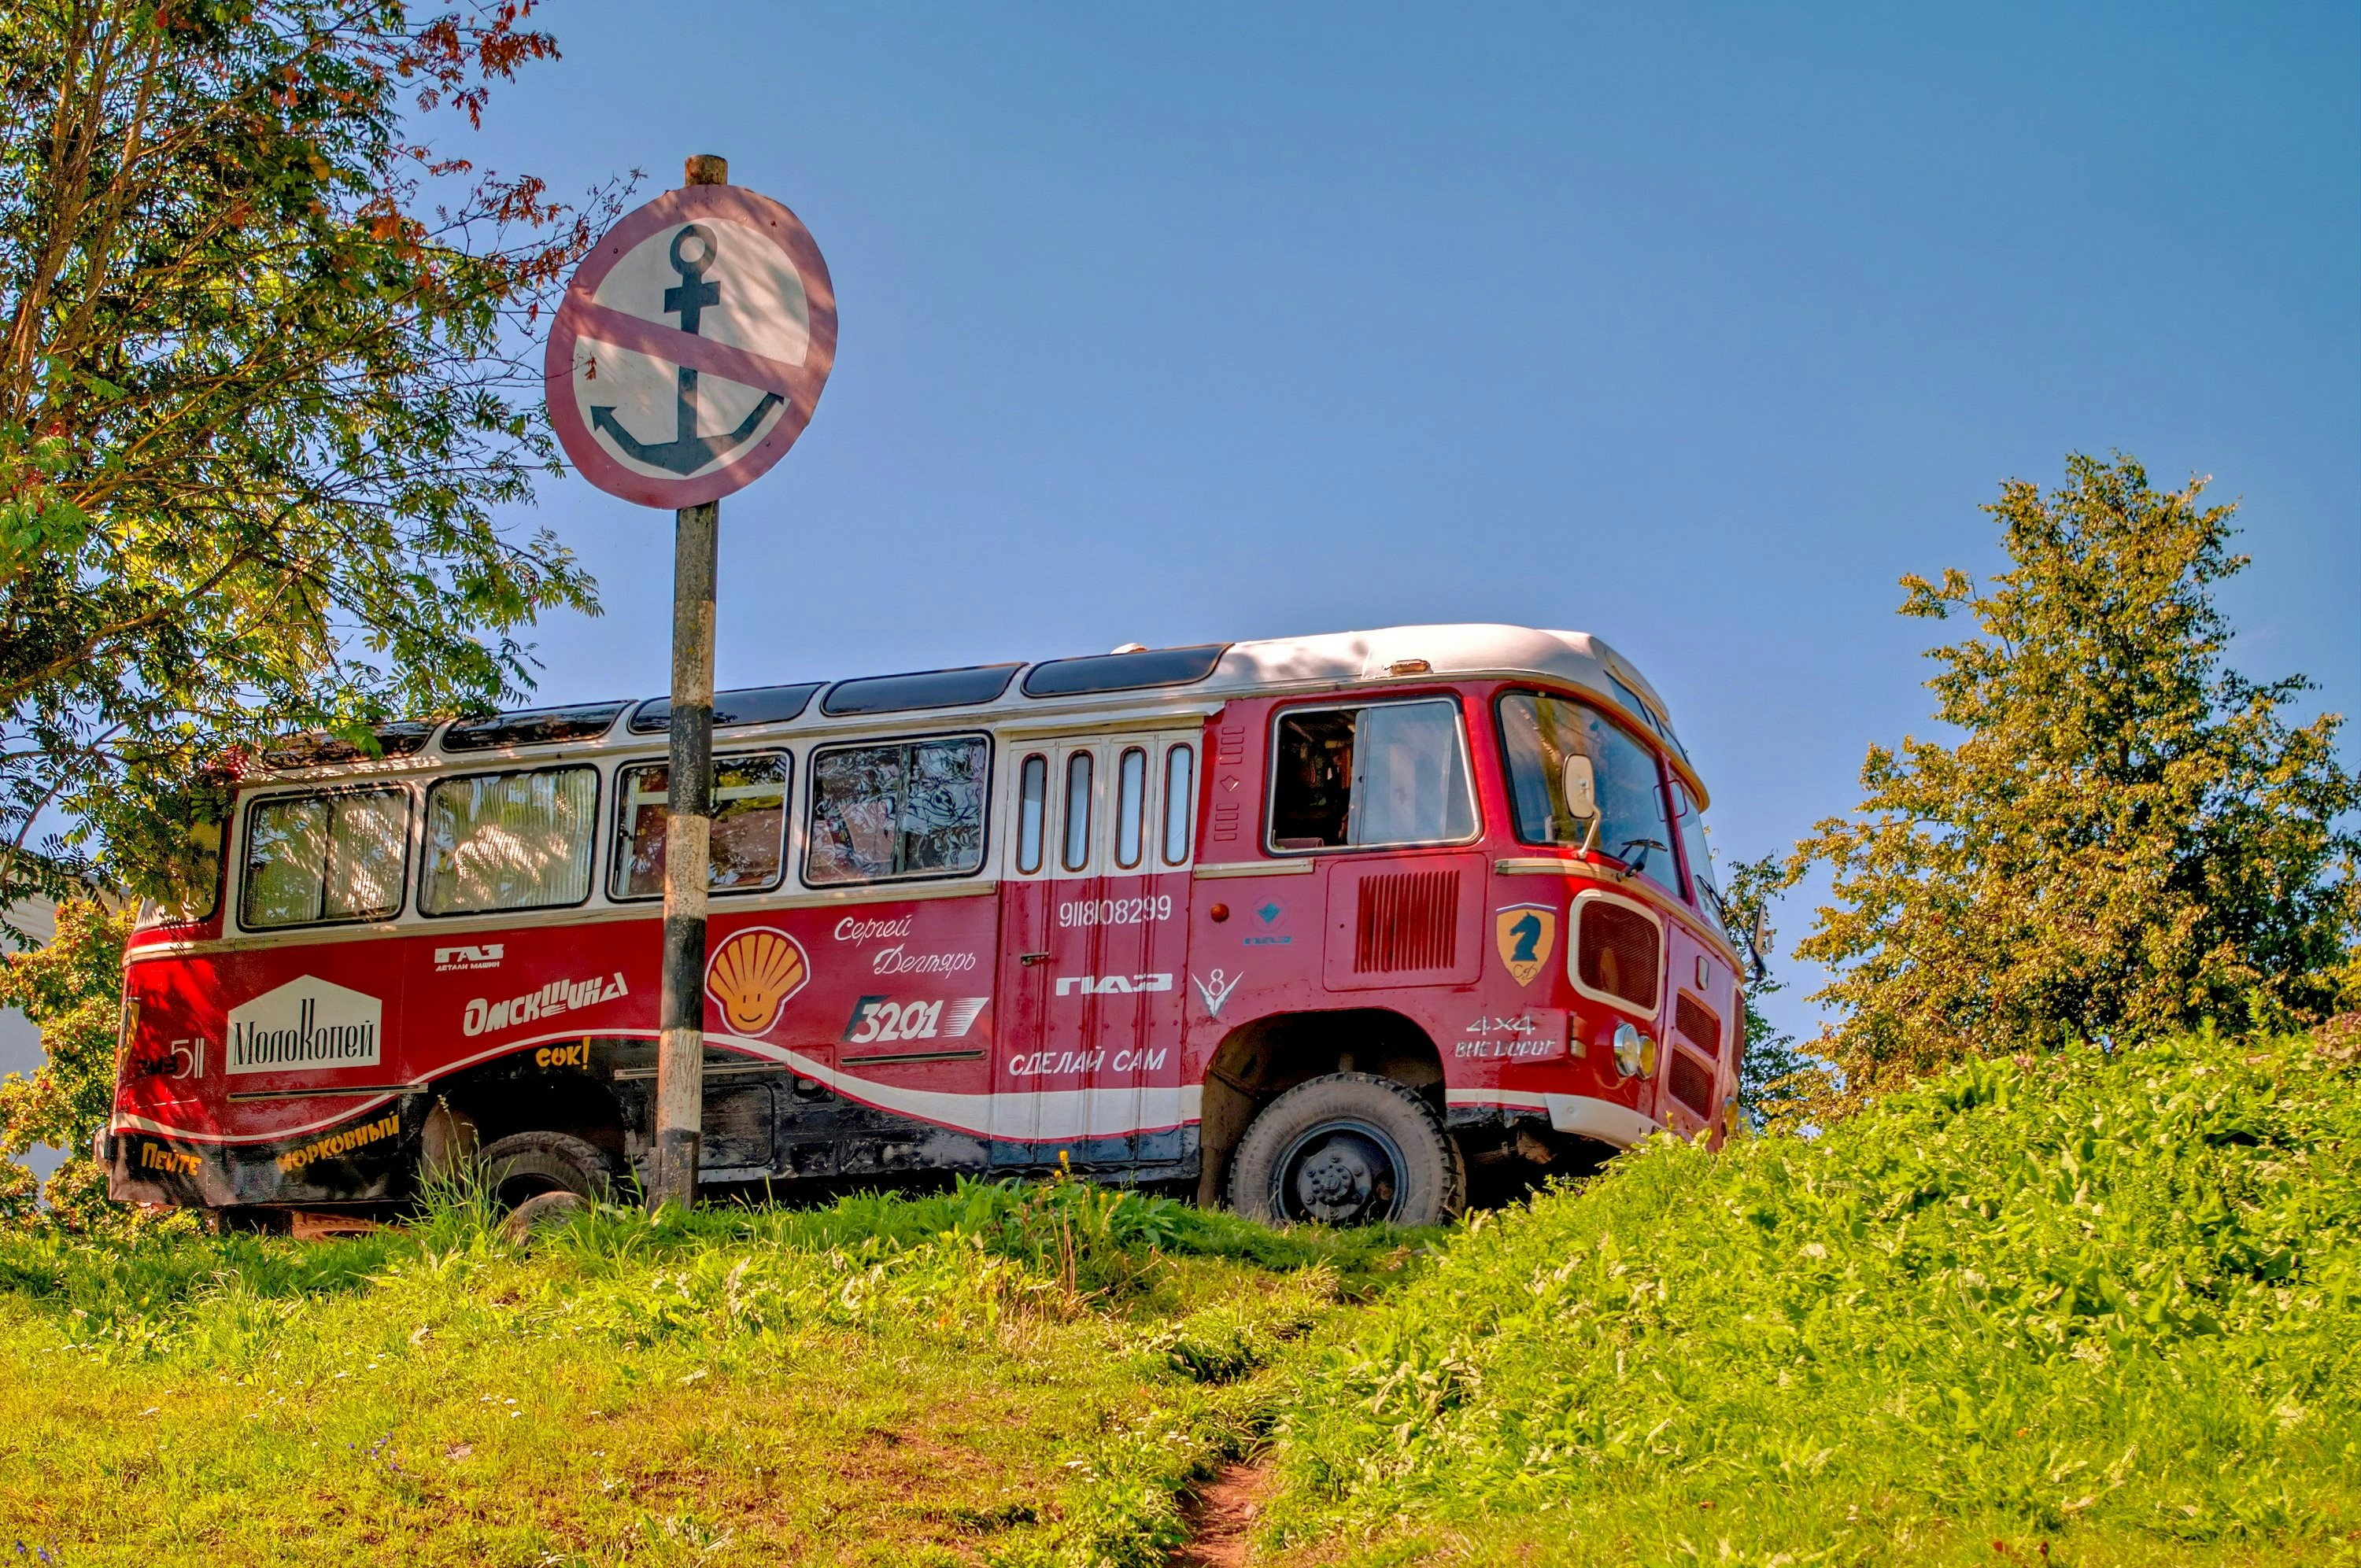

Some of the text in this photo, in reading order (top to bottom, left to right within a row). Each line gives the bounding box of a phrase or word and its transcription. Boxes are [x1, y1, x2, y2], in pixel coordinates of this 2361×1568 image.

[1059, 895, 1172, 928] 9118108299
[834, 914, 913, 947] Сергей
[434, 944, 504, 964] ГАЗ
[435, 961, 501, 972] ДЕТАЛИ МАШИН
[1055, 973, 1173, 996] ПАЗ
[171, 1038, 205, 1079] 511
[1009, 1046, 1167, 1076] СДЕЛАЙ САМ
[275, 1110, 400, 1175] МОРКОВНЫЙ
[535, 1036, 591, 1070] СОК!
